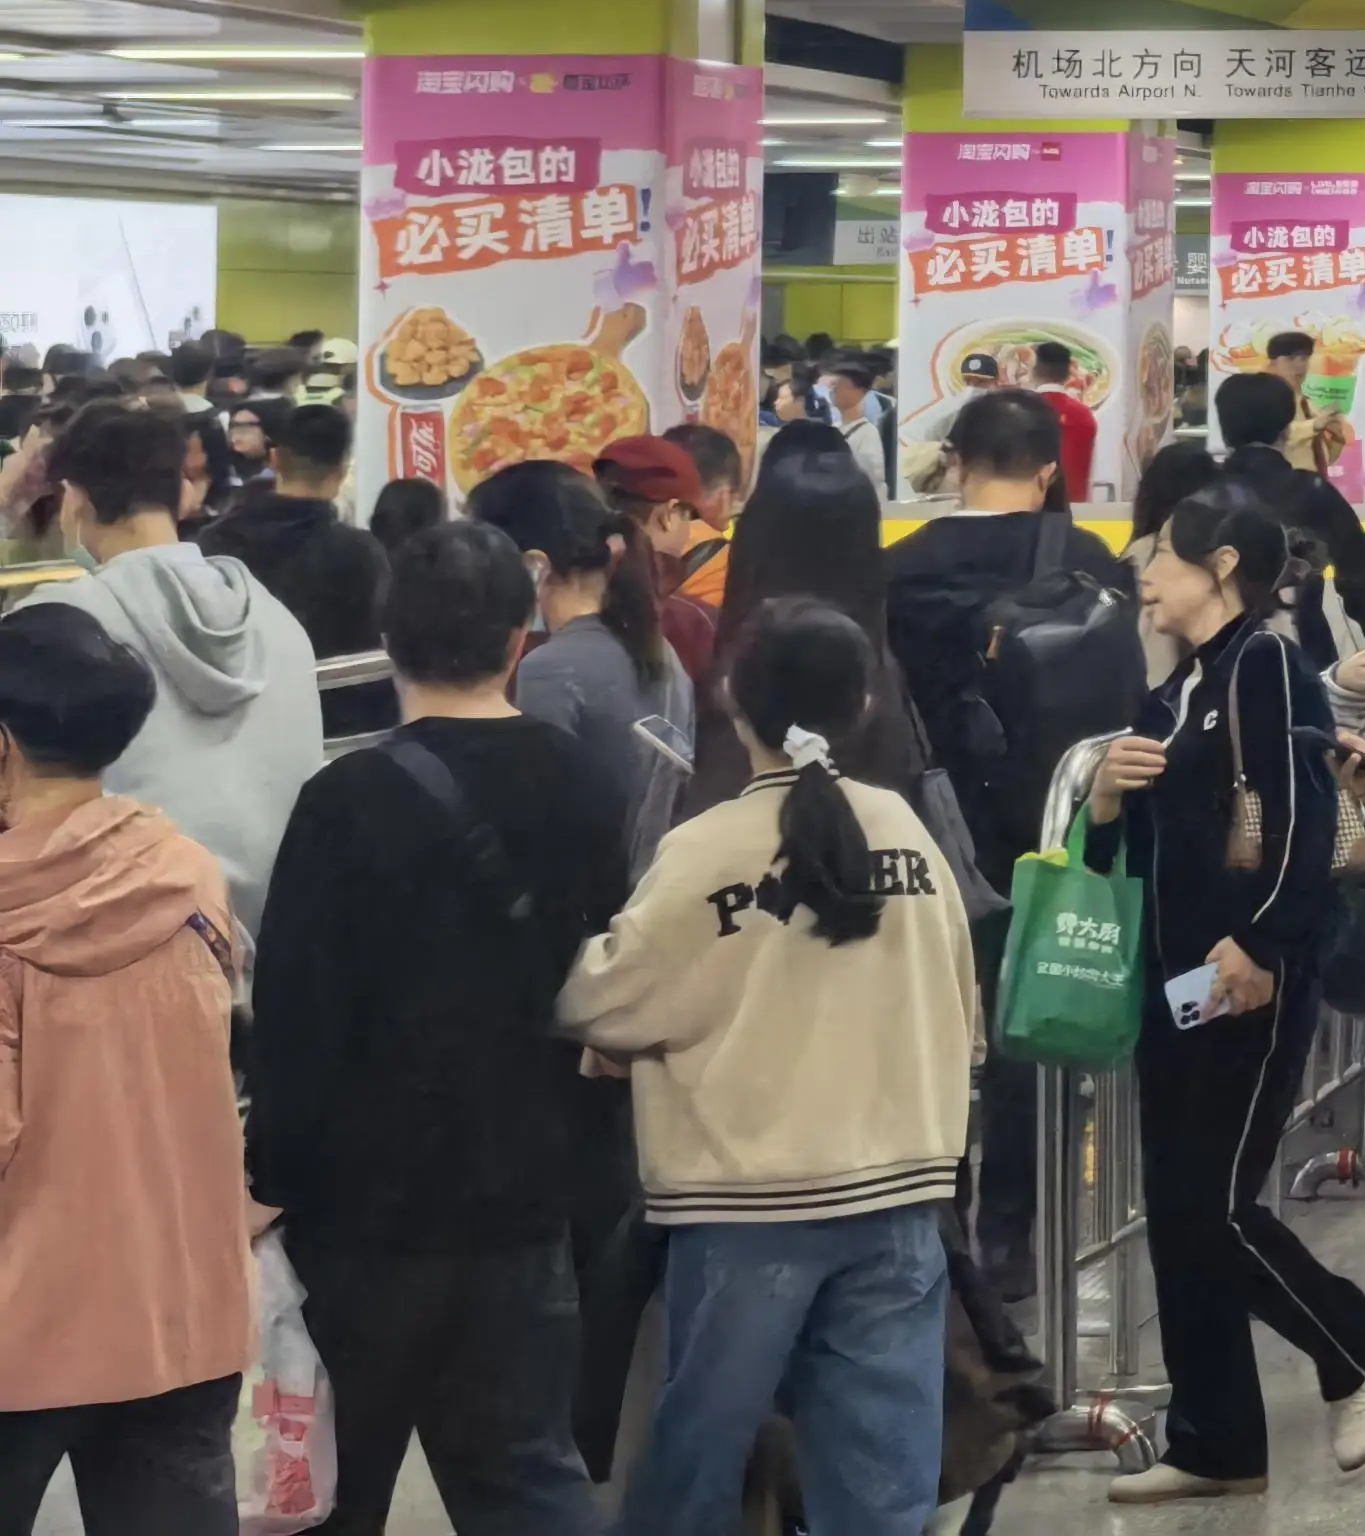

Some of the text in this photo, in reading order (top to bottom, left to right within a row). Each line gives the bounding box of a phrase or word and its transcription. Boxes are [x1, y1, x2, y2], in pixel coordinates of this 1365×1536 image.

[1012, 47, 1202, 80] 机场北方向
[1039, 84, 1110, 99] Towards
[1118, 83, 1175, 102] Airport
[1226, 83, 1293, 99] Towards
[1302, 83, 1356, 99] Tianhe
[417, 147, 576, 187] 小泷包的
[942, 199, 1060, 228] 小泷包的
[1243, 225, 1336, 249] 小泷包的
